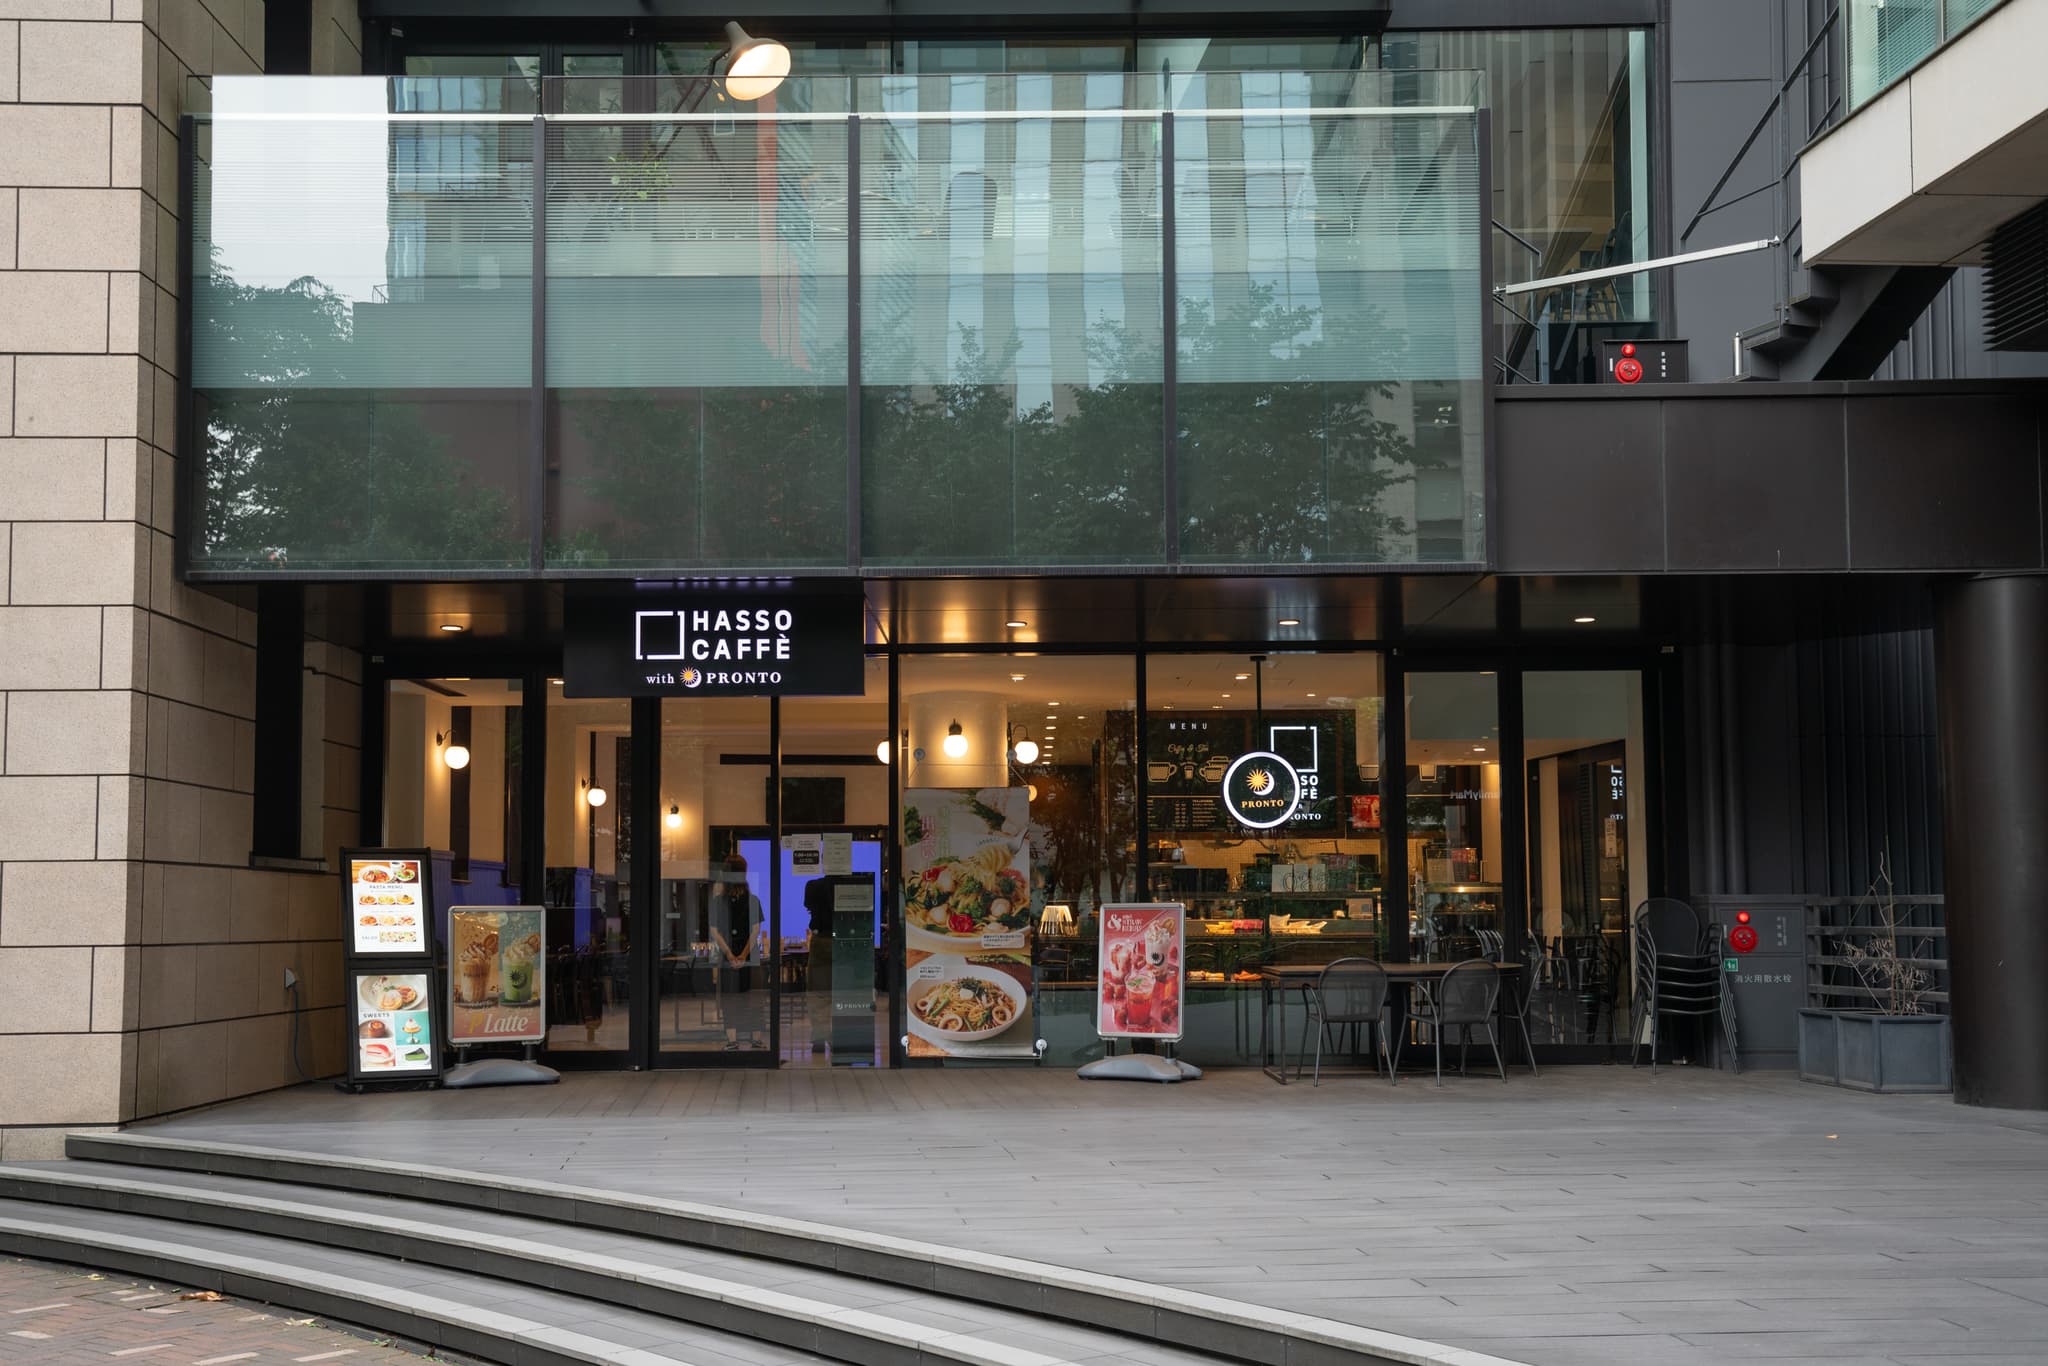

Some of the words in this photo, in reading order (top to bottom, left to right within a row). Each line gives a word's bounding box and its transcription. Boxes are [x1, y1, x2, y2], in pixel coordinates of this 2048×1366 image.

[692, 610, 792, 631] HASSO
[692, 634, 790, 660] CAFFÈ
[646, 672, 675, 684] with
[706, 672, 782, 684] PRONTO
[1169, 722, 1208, 730] MENU
[1300, 775, 1319, 786] SO
[1300, 786, 1318, 799] FÈ
[1241, 800, 1285, 809] PRONTO
[484, 1013, 529, 1034] Latte
